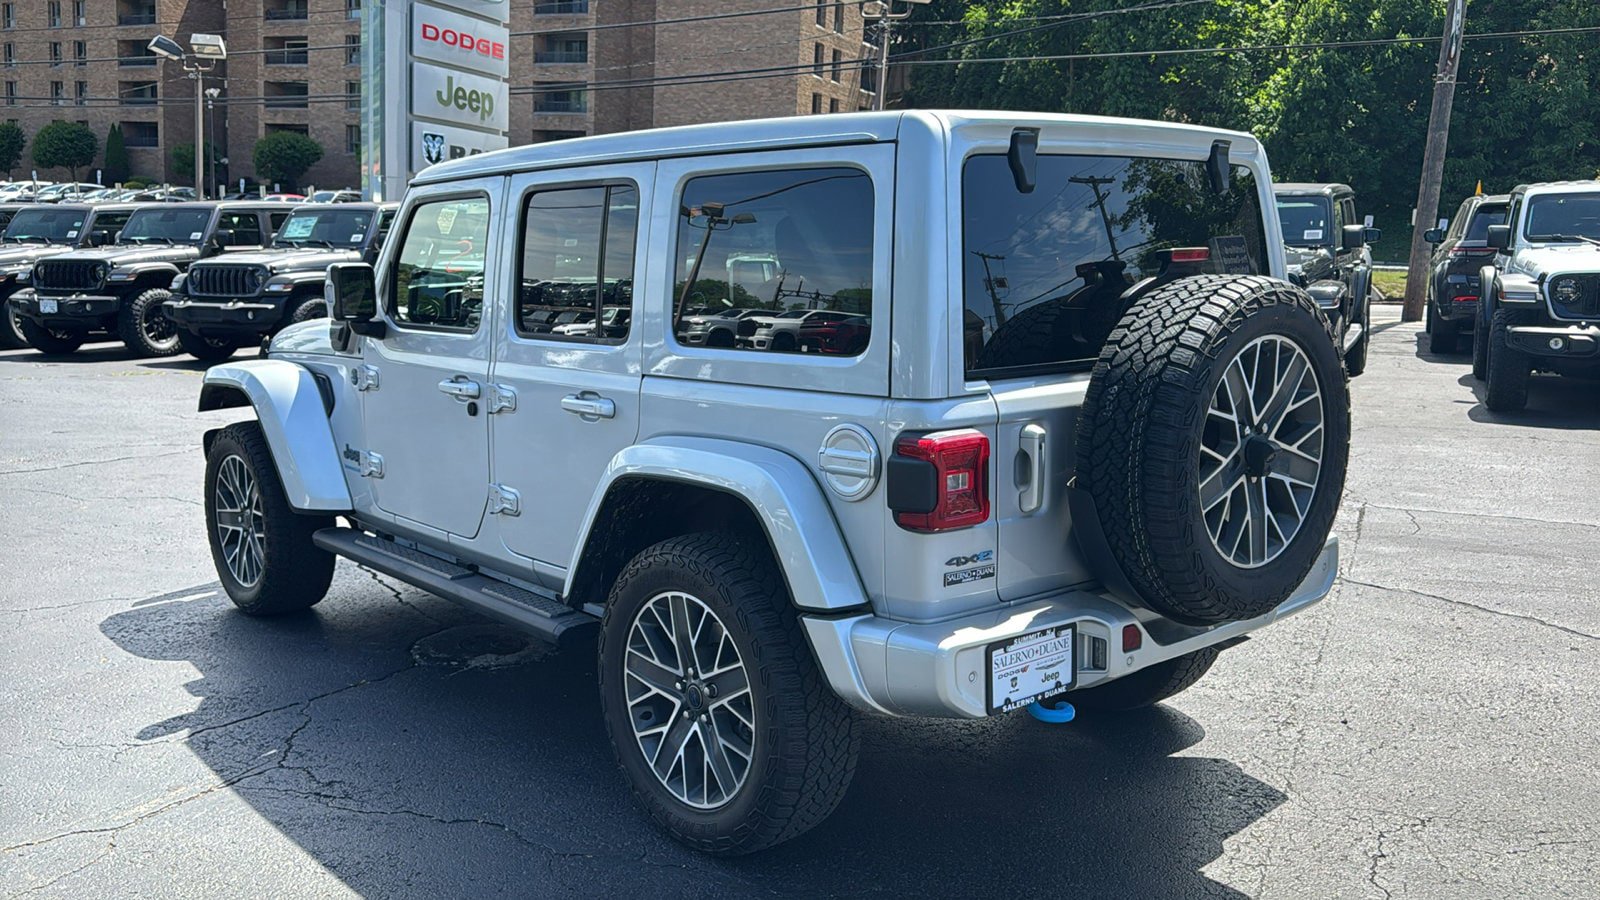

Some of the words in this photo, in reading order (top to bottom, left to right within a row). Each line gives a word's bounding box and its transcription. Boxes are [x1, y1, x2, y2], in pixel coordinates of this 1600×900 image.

[422, 23, 504, 59] DODGE
[436, 76, 494, 121] Jeep
[994, 648, 1035, 671] SALERNO
[1039, 637, 1070, 656] DUANE
[1041, 671, 1060, 683] Jeep
[1002, 696, 1035, 713] SALERNO
[1044, 685, 1067, 699] DUANE
